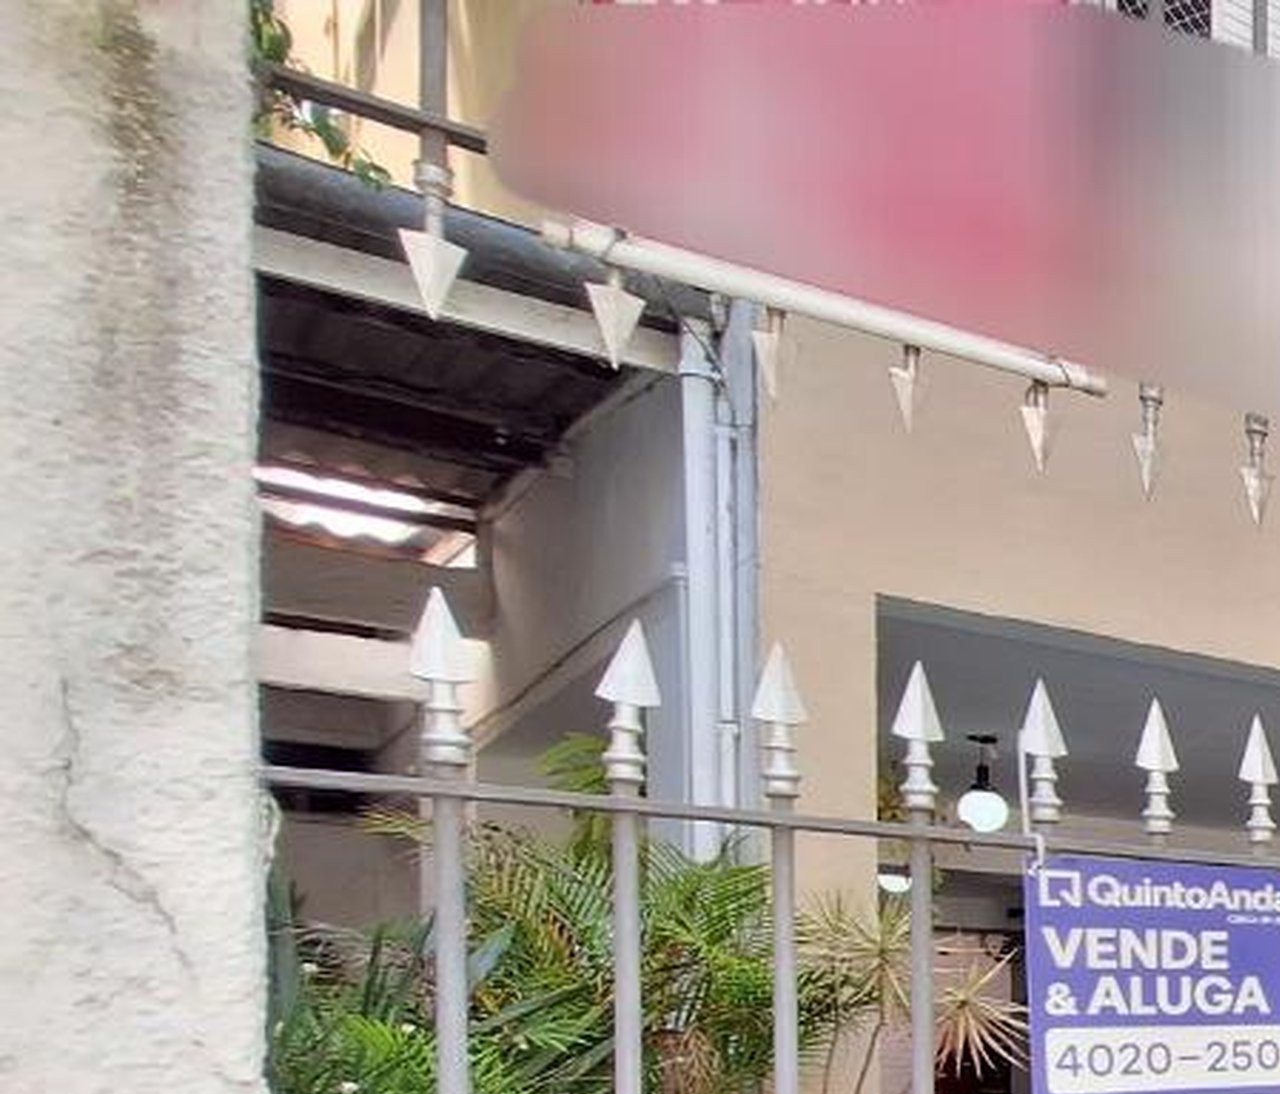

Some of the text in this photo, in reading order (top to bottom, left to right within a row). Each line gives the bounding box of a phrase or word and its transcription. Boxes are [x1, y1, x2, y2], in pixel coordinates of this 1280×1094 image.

[1041, 926, 1230, 970] VENDE
[1045, 974, 1272, 1016] & ALUGA
